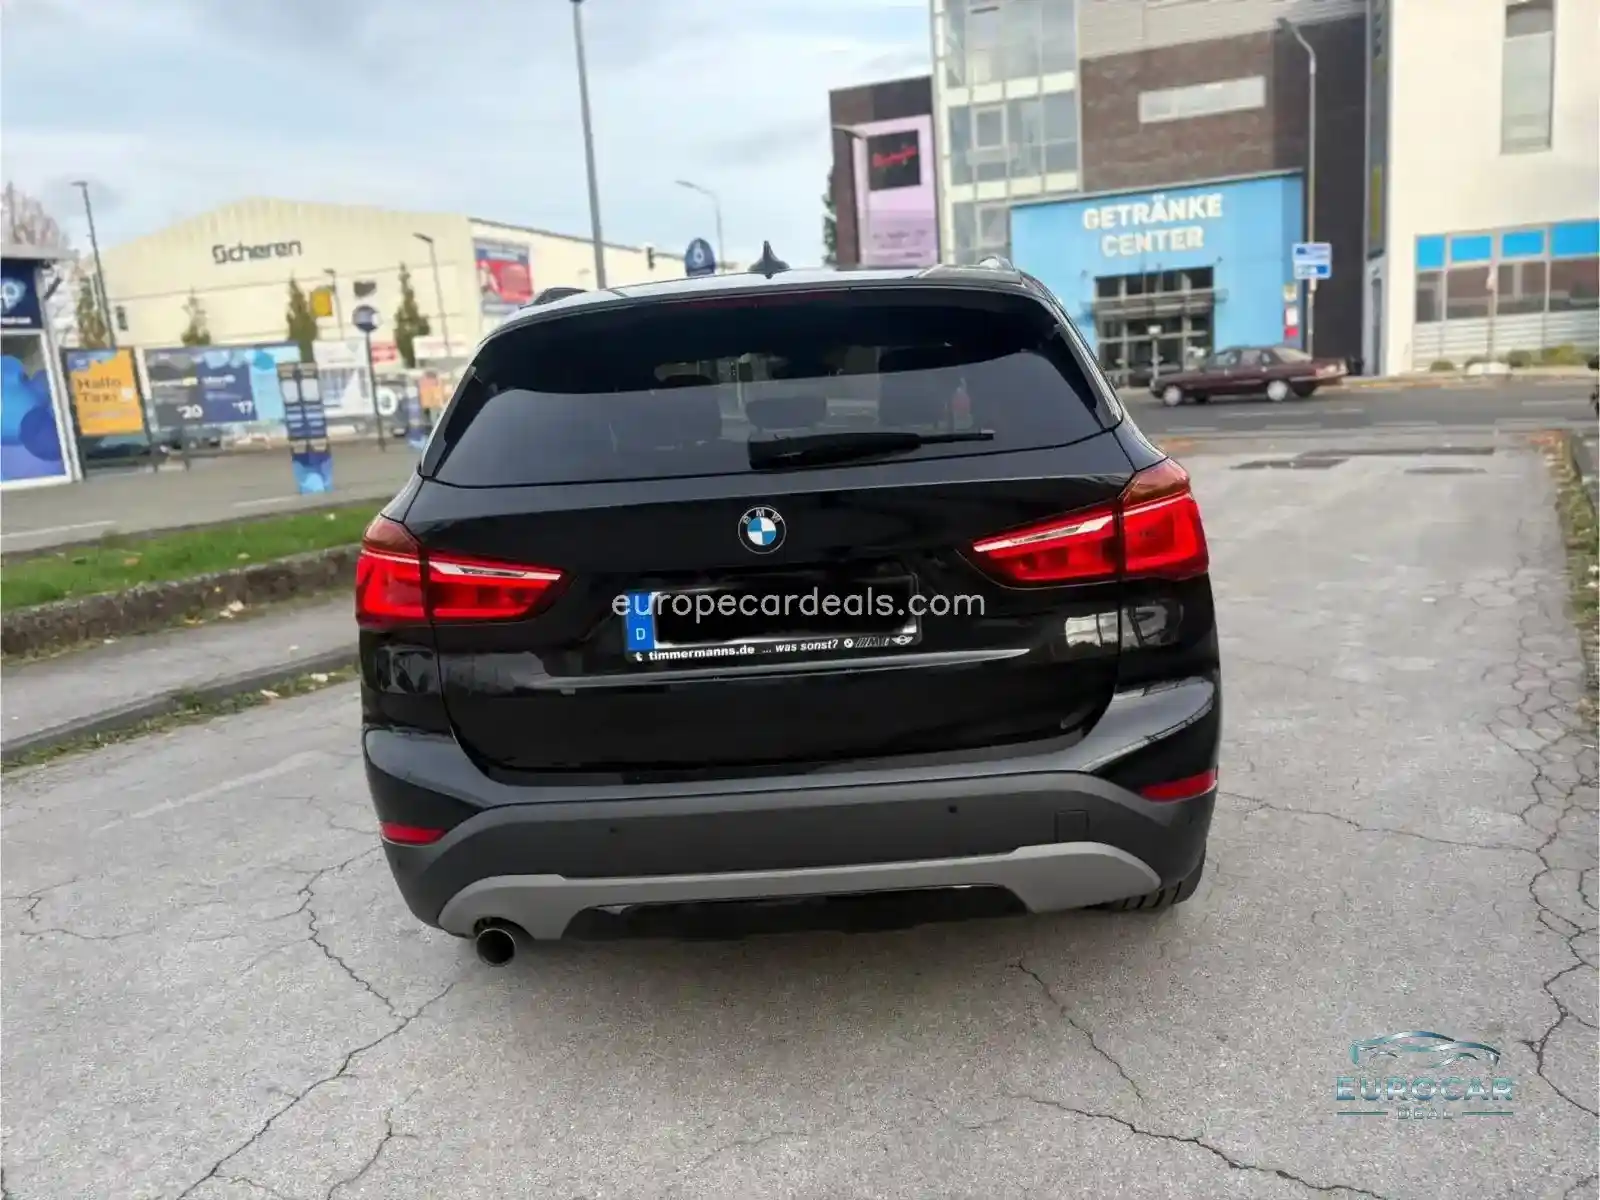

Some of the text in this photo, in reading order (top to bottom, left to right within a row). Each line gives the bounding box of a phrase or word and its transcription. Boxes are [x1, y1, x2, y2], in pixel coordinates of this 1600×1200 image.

[1083, 193, 1223, 230] GETRÄNKE
[1101, 225, 1205, 257] CENTER
[635, 627, 646, 641] D
[649, 645, 755, 661] timmermanns.de
[775, 643, 797, 653] was
[800, 639, 839, 651] sonst?
